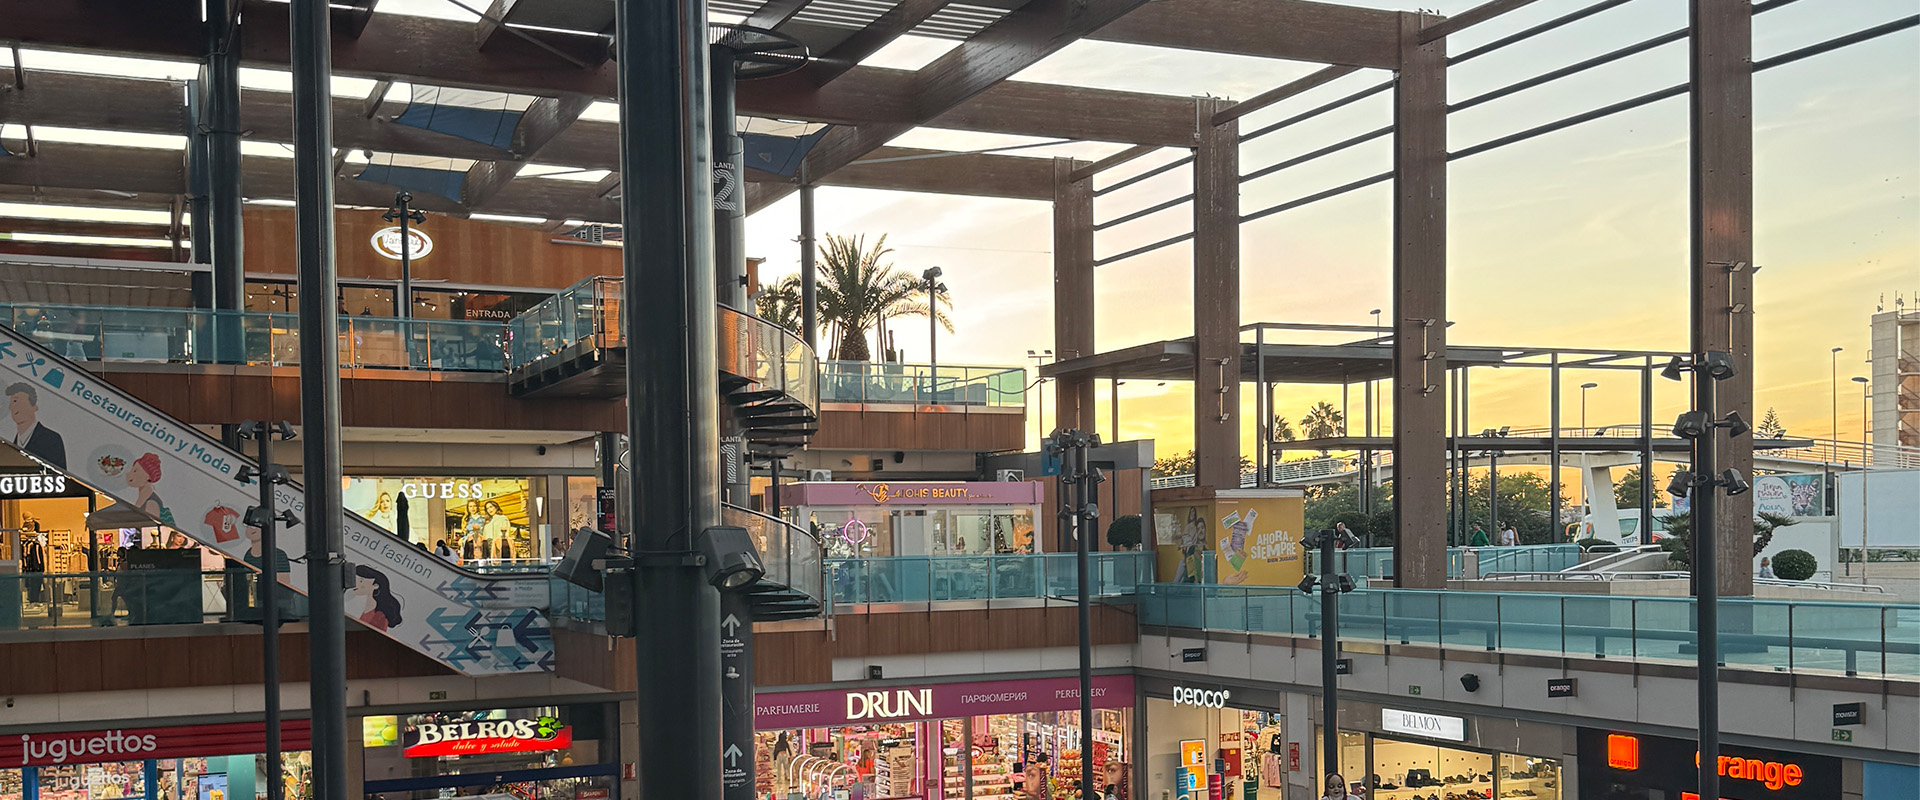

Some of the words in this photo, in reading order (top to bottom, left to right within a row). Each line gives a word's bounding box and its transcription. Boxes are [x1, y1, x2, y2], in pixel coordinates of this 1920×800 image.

[713, 162, 735, 170] LANTA
[713, 169, 736, 210] 2
[466, 309, 511, 319] ENTRADA
[71, 380, 176, 445] Restauración
[175, 439, 189, 452] y
[189, 443, 232, 474] Moda
[720, 444, 737, 484] 1
[0, 475, 66, 494] GUESS
[401, 482, 483, 499] GUESS
[932, 488, 968, 498] BEAUTY
[1256, 530, 1289, 546] AHORA
[351, 530, 381, 550] and
[381, 544, 433, 580] fashion
[1251, 541, 1296, 560] SIEMPRE
[961, 692, 1028, 704] ПАРФЮМЕРИЯ
[1055, 687, 1107, 699] PERFUERY
[756, 703, 820, 716] PARFUMERIE
[846, 688, 933, 720] DRUNI
[416, 718, 539, 746] BELROS
[1402, 713, 1442, 732] BELMON
[21, 730, 157, 765] juguettos
[452, 741, 477, 751] dulce
[481, 743, 487, 753] y
[490, 739, 521, 750] salado
[1695, 750, 1803, 790] range
